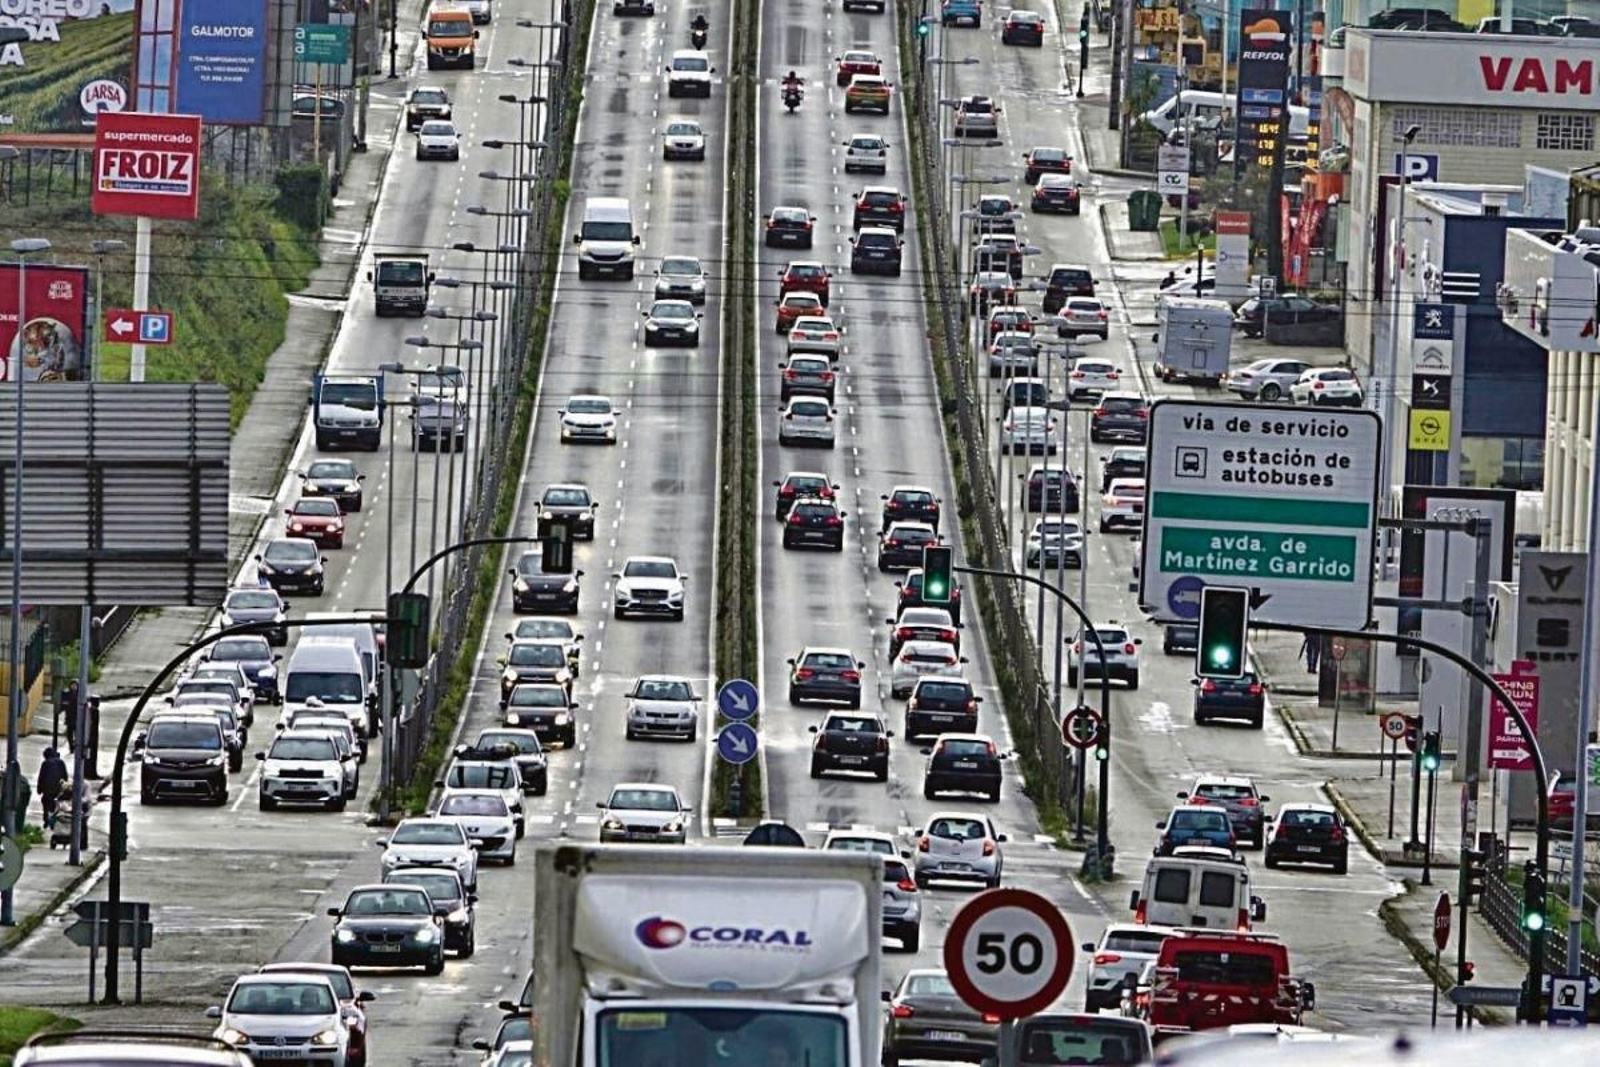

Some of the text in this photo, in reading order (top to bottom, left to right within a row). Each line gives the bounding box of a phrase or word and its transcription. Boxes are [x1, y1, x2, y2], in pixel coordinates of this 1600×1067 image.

[191, 25, 254, 37] GALMOTOR
[1242, 51, 1285, 60] REPSOL
[1480, 56, 1593, 95] VAM
[85, 84, 121, 105] LARSA
[104, 132, 193, 143] supermercado
[103, 151, 190, 180] FROIZ
[1405, 156, 1429, 181] P
[149, 318, 162, 332] P
[1225, 416, 1251, 433] de
[1261, 418, 1349, 437] servicio
[1223, 448, 1351, 469] estación de
[1222, 466, 1334, 487] autobuses
[1210, 535, 1307, 554] avda. de
[1269, 556, 1351, 577] Garrido
[689, 926, 813, 945] CORAL
[976, 933, 1044, 975] 50
